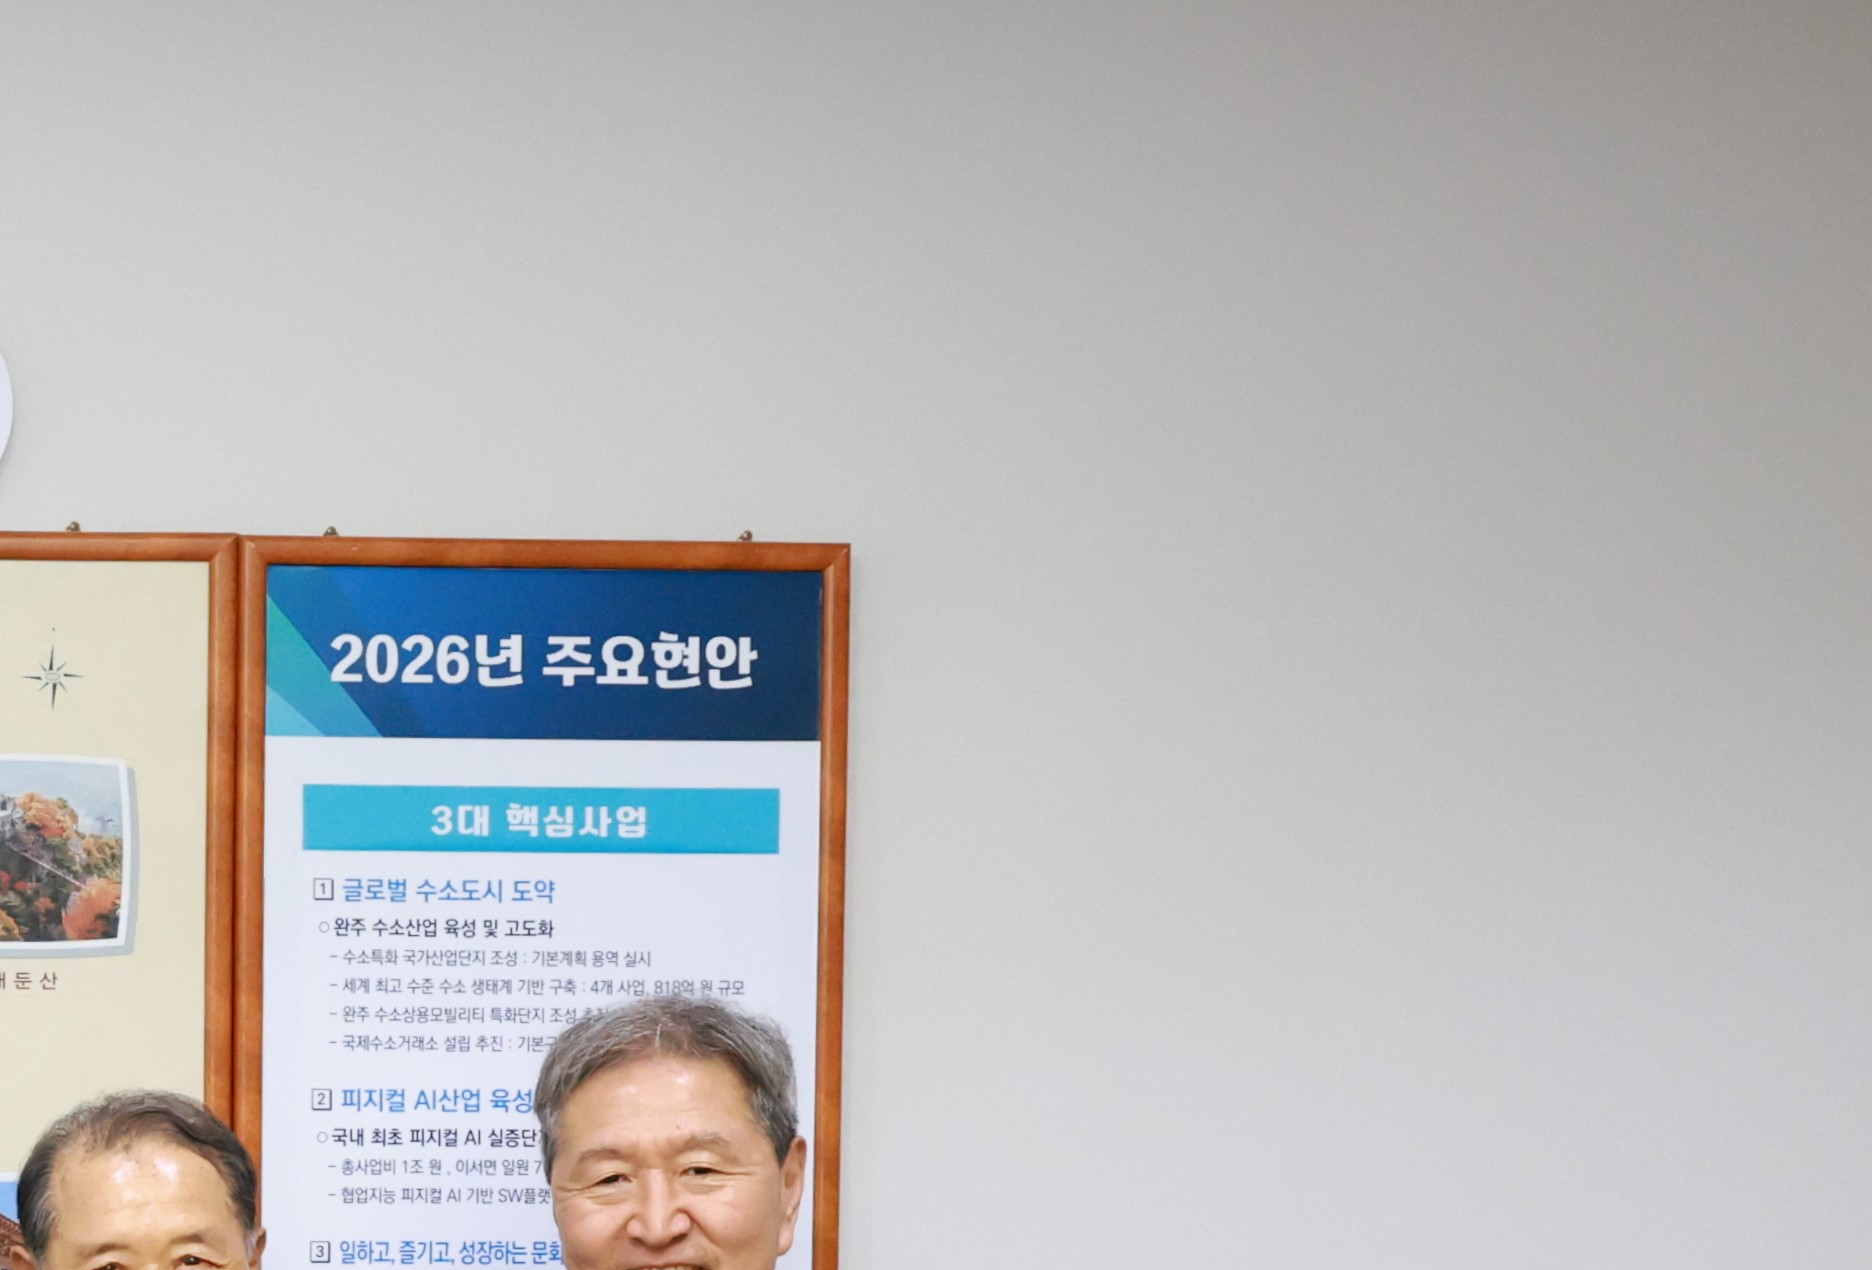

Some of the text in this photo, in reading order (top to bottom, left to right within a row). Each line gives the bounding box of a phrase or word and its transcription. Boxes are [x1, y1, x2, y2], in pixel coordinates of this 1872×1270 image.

[328, 629, 759, 691] 2026년 주요현안
[429, 800, 649, 841] 3대 핵심사업
[341, 876, 556, 904] 글로벌 수소도시 도약
[333, 917, 555, 939] 완주 수소산업 육성 및 고도화
[342, 948, 651, 968] 수소특화 국가산업단지 조성 기본계획 용역 실시
[341, 976, 745, 997] 세계 최고 수준 수소 생태계 기반 구축 규모
[342, 1006, 545, 1024] 완주 수소상용모빌리티 특화단지
[342, 1034, 503, 1053] 국제수소거래소 설립 추진
[340, 1087, 535, 1114] 피지컬 AI산업 육성
[331, 1128, 458, 1148] 국내 최초 피지컬
[340, 1158, 530, 1178] 총사업비 이서면 일원
[340, 1187, 494, 1205] 협업지능 피지컬 기반
[338, 1239, 529, 1266] 일하고, 즐기고, 성장하는
